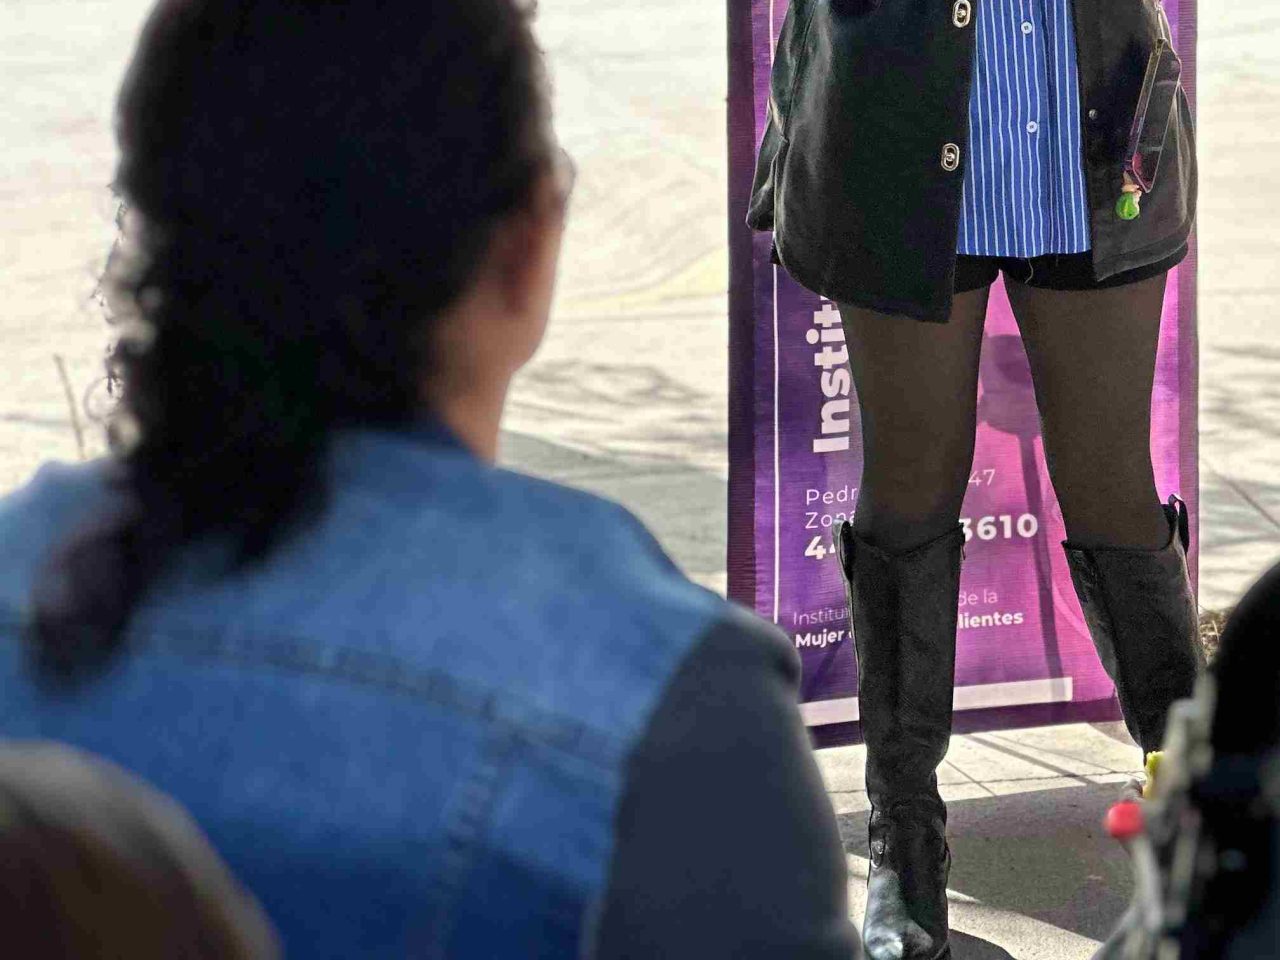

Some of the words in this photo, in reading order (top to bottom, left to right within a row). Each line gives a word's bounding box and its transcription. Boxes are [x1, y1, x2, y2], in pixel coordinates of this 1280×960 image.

[806, 295, 850, 453] Instit
[806, 485, 857, 506] Pedr
[968, 469, 996, 487] 47
[804, 535, 836, 560] 4
[983, 588, 998, 604] la
[795, 628, 845, 648] Mujer
[958, 611, 1024, 629] lientes
